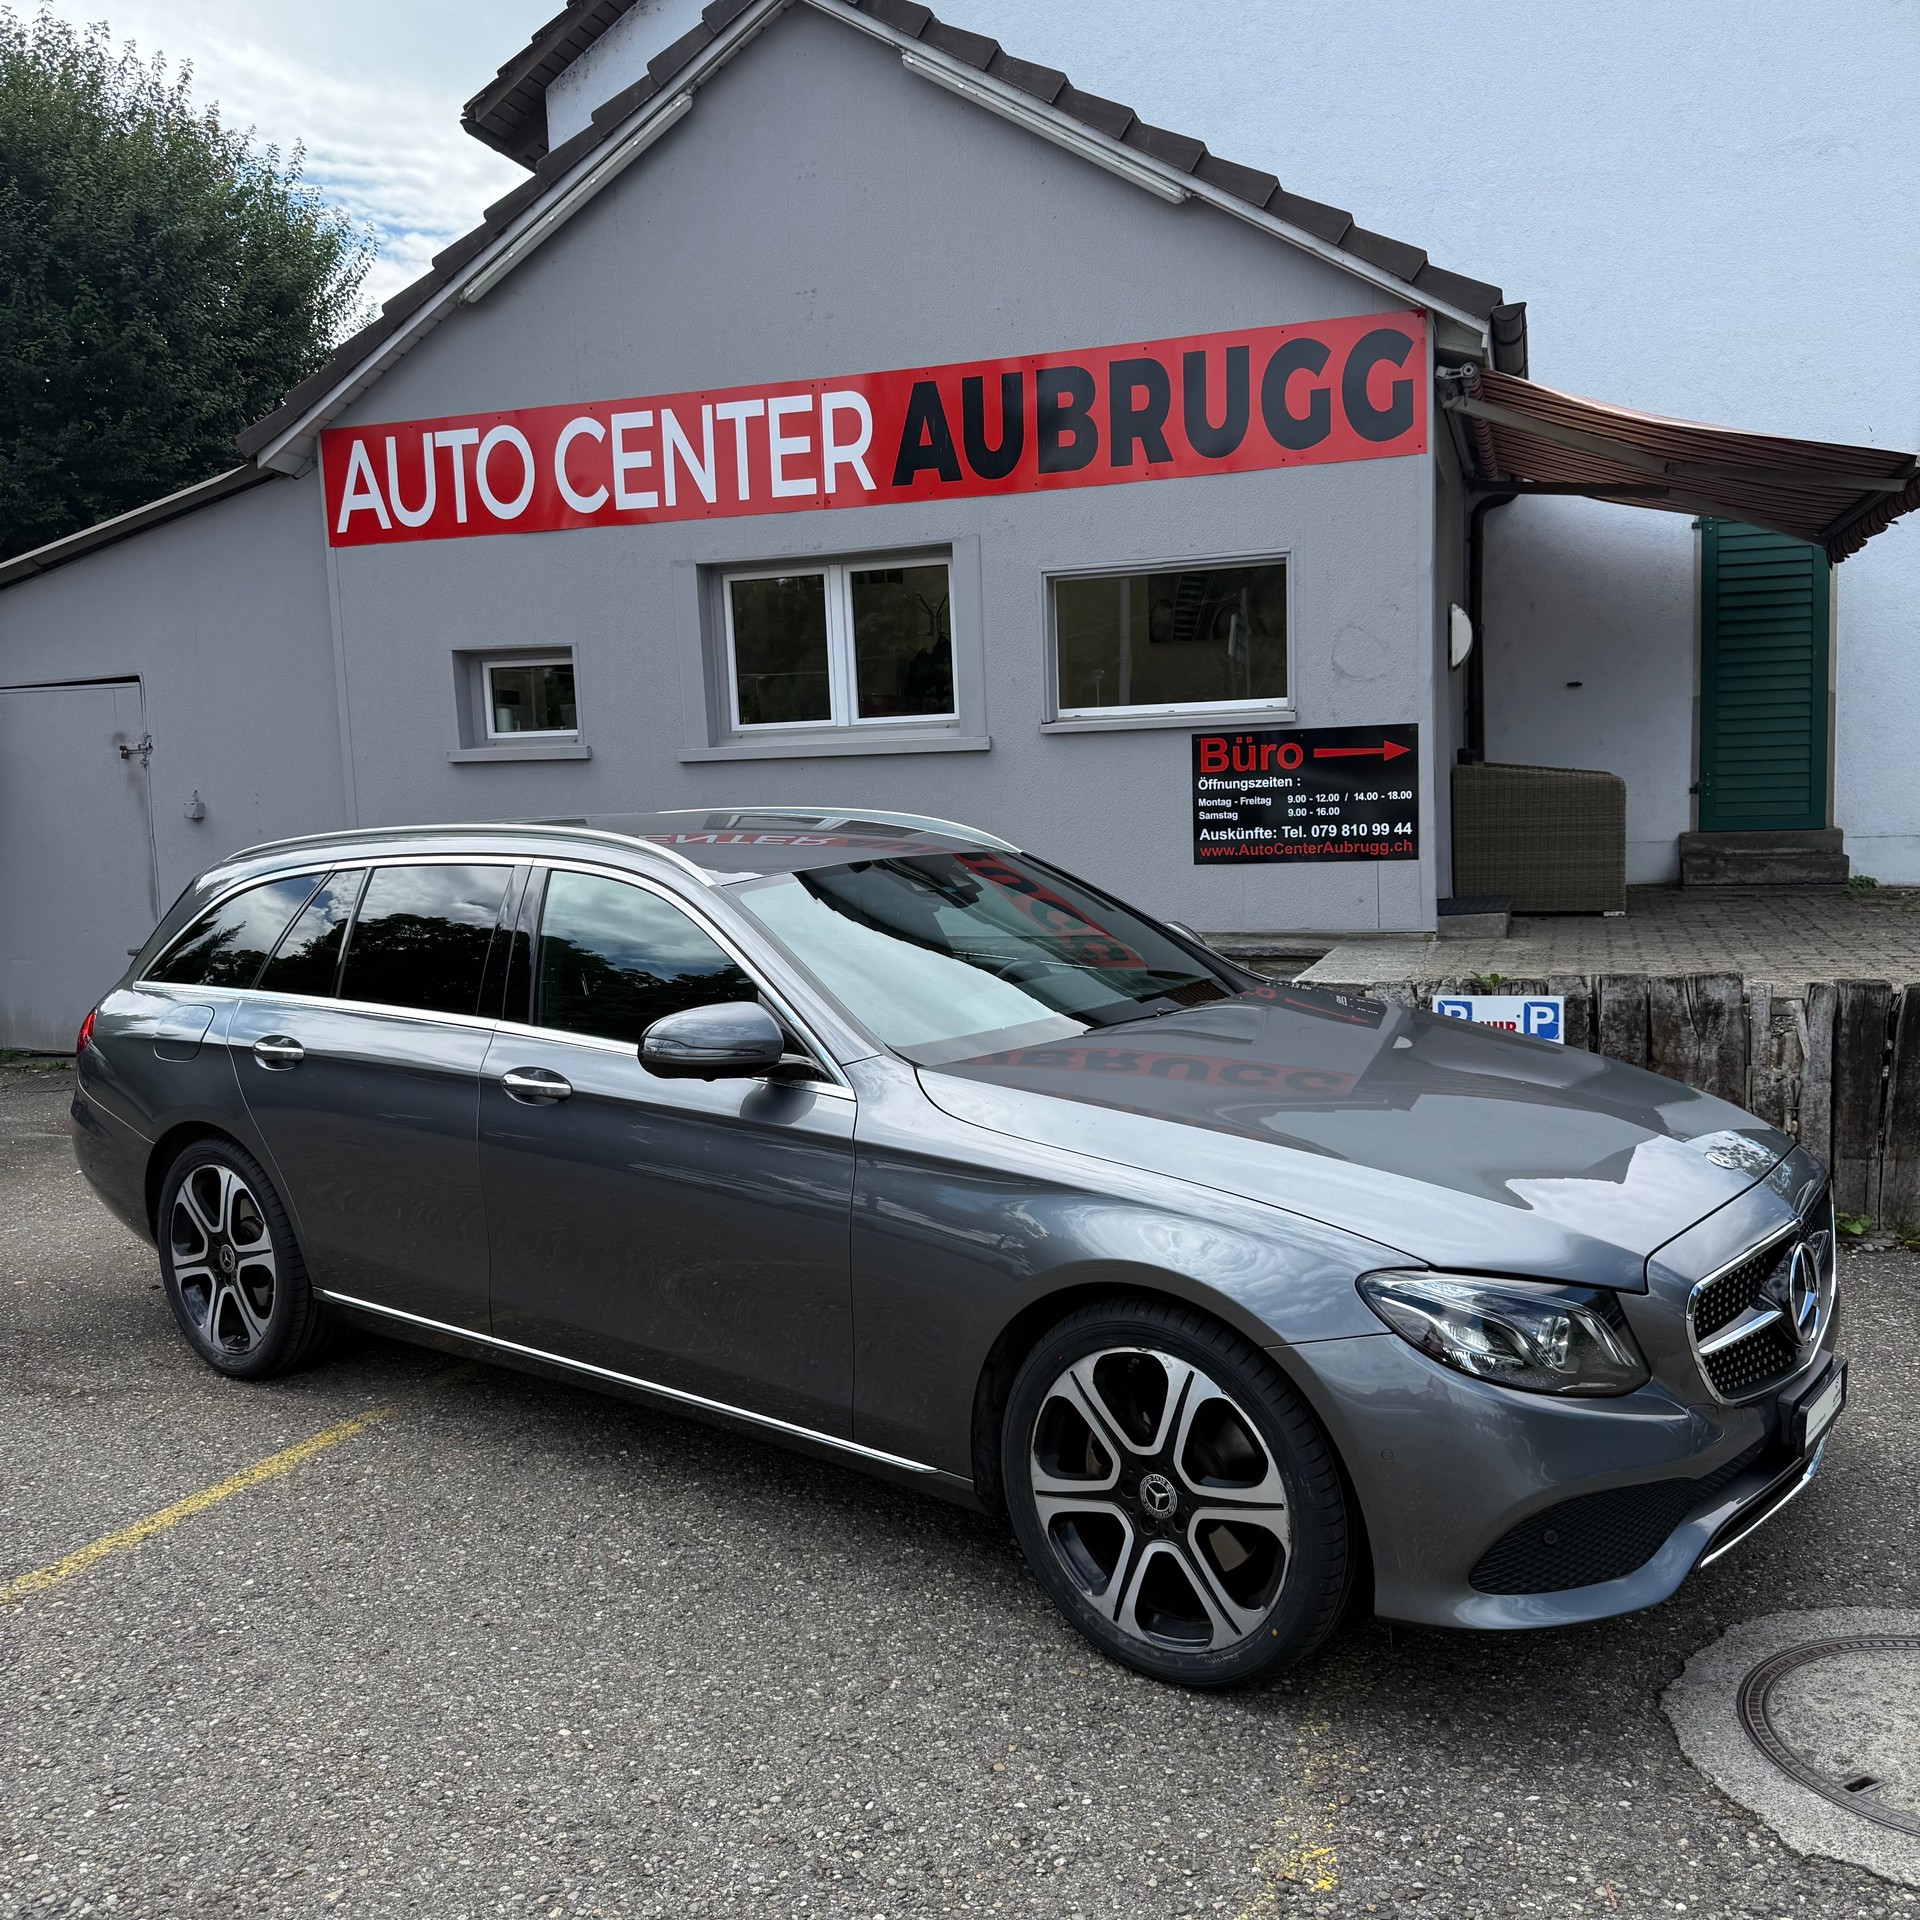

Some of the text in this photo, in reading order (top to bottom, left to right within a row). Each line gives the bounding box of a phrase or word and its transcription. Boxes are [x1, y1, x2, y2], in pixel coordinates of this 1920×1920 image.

[337, 328, 1415, 534] AUTO CENTER AUBRUGG
[1200, 736, 1304, 773] Büro
[1198, 777, 1293, 791] Öffnungszeiten
[1198, 798, 1232, 808] Montag
[1240, 796, 1272, 806] Freitag
[1287, 794, 1307, 804] 9.00
[1315, 793, 1340, 803] 12.00
[1353, 791, 1379, 801] 14.00
[1387, 790, 1413, 800] 18.00
[1198, 811, 1238, 821] Samstag
[1287, 808, 1307, 817] 9.00
[1315, 806, 1340, 816] 16.00
[1199, 821, 1413, 841] Auskünfte: Tel. 079 810 99 44
[1199, 839, 1413, 857] www.AutoCenterAubrugg.ch
[1530, 1006, 1554, 1034] P
